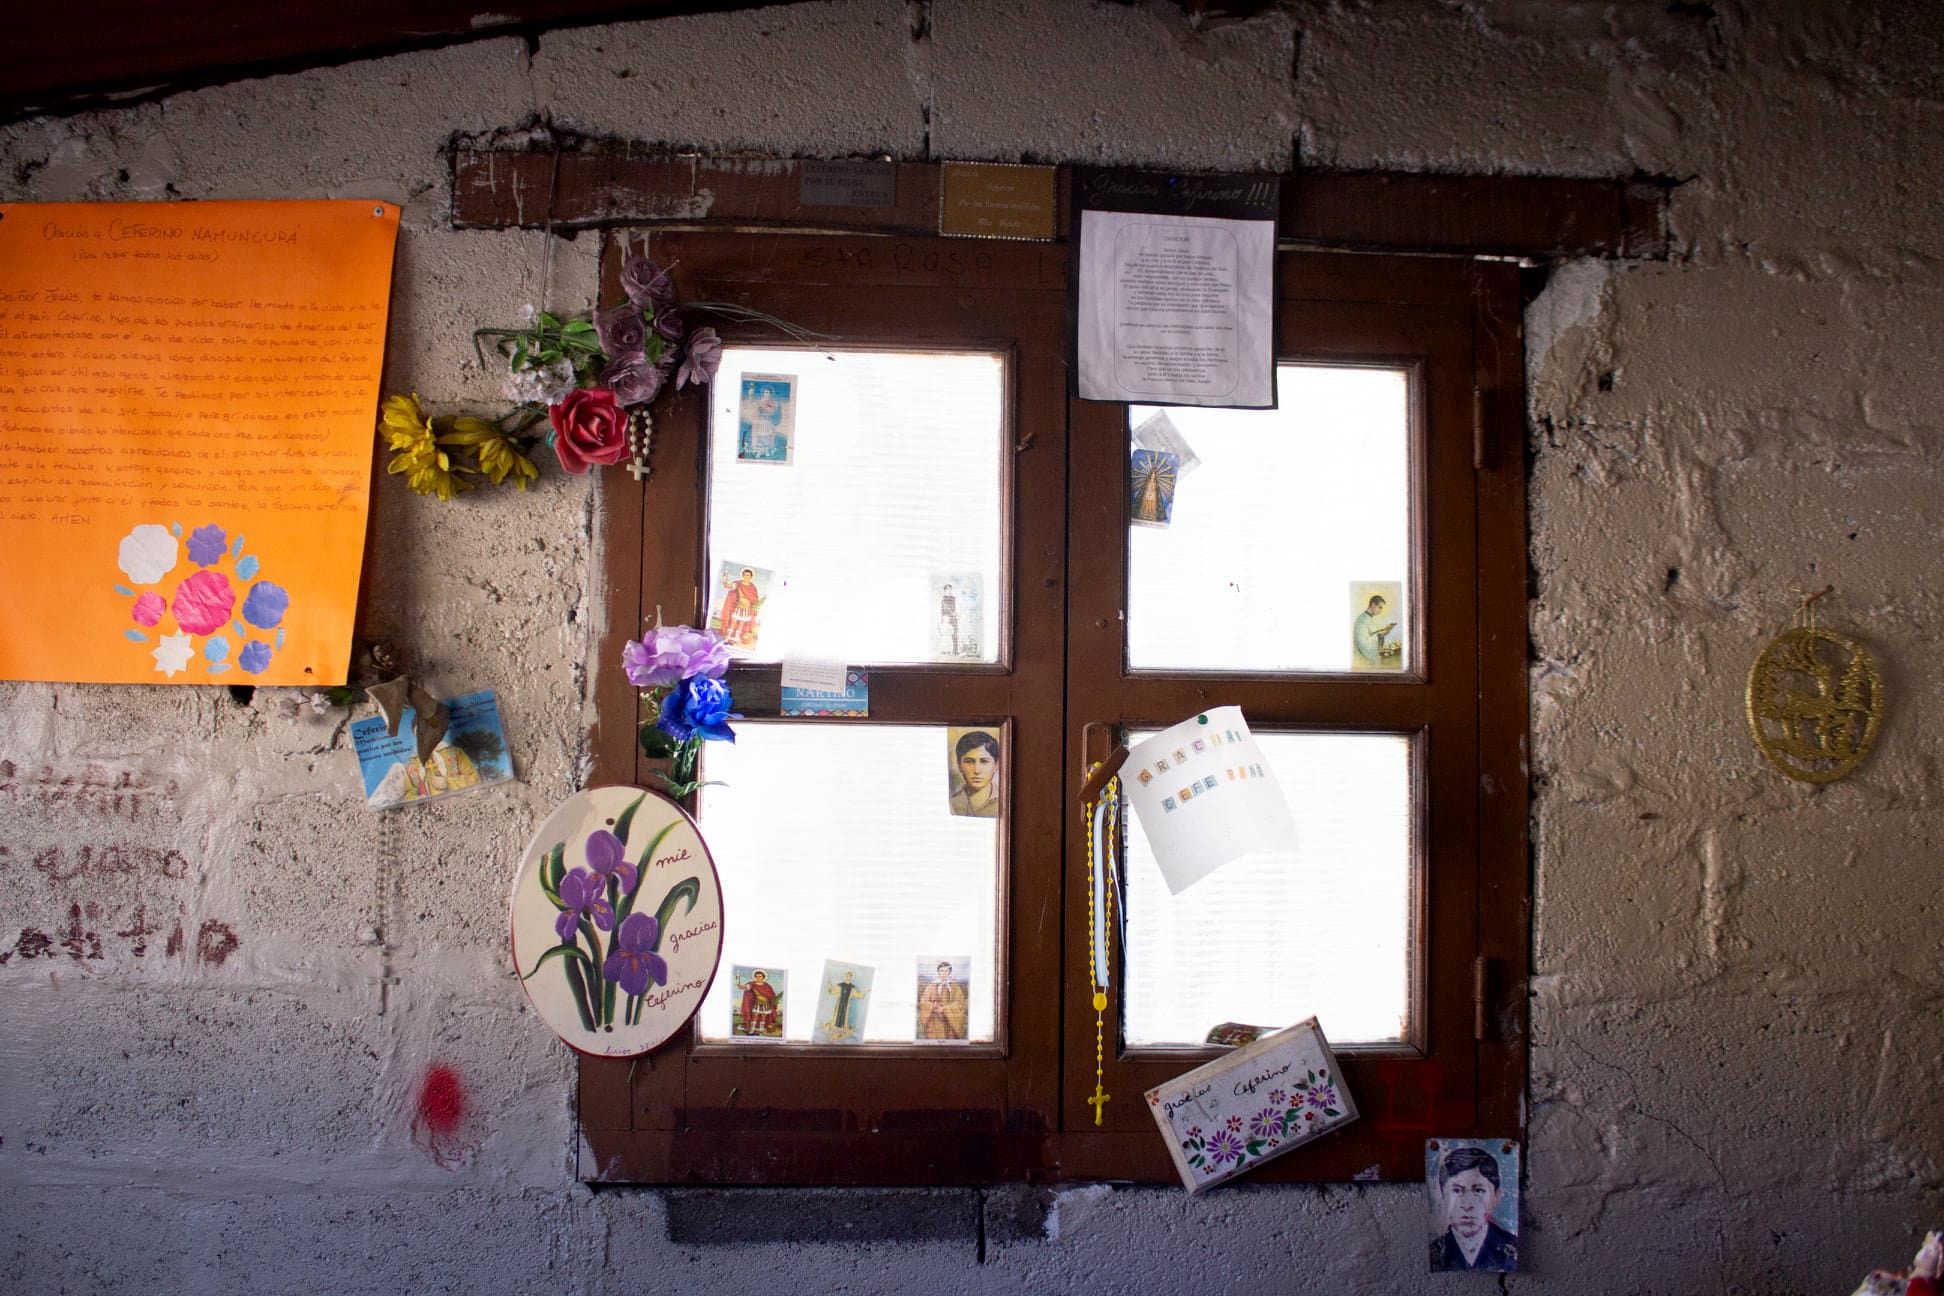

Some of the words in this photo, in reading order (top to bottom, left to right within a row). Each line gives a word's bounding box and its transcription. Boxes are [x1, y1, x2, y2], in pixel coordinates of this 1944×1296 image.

[669, 921, 719, 952] gracias
[645, 978, 708, 1011] Ceferino
[1232, 1060, 1293, 1097] Ceferino
